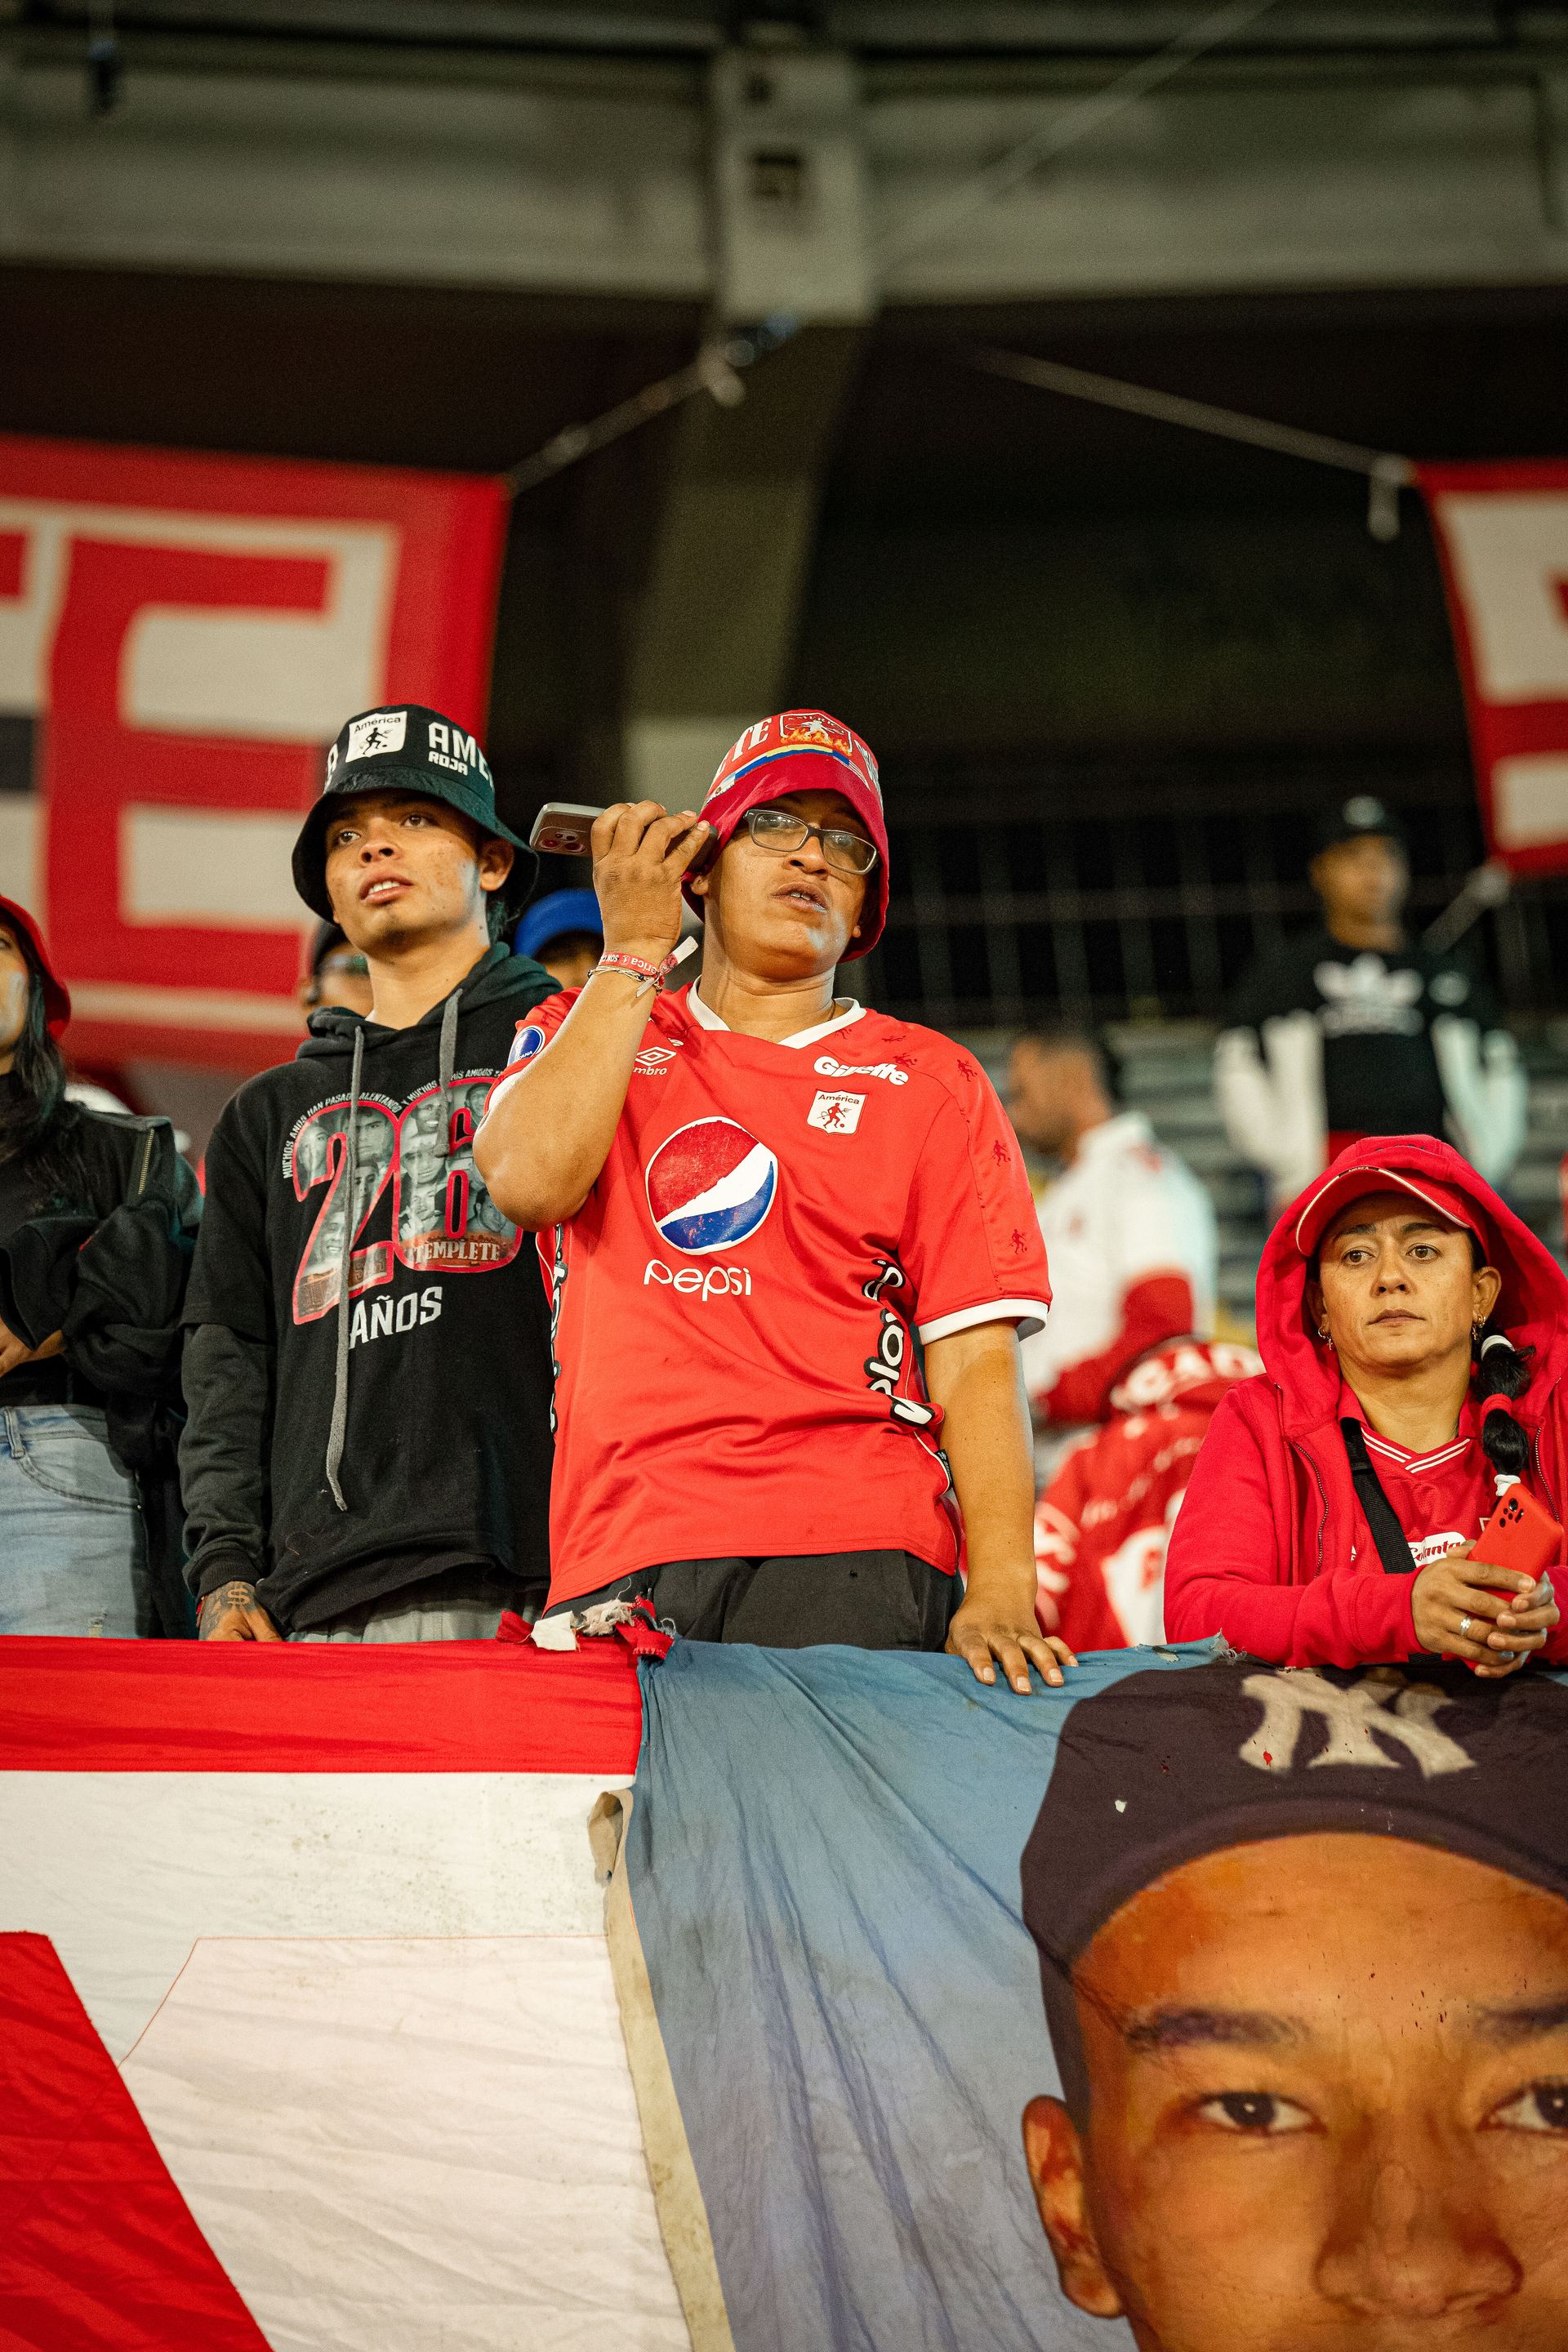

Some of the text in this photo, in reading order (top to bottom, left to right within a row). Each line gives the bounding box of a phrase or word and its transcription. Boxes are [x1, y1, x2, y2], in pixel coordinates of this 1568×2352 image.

[354, 716, 401, 733] América
[630, 956, 657, 974] erica
[633, 1067, 667, 1076] mbro
[325, 1092, 352, 1107] PASAD
[818, 1094, 859, 1104] América
[643, 1258, 752, 1302] pepsi
[349, 1286, 443, 1350] AÑOS
